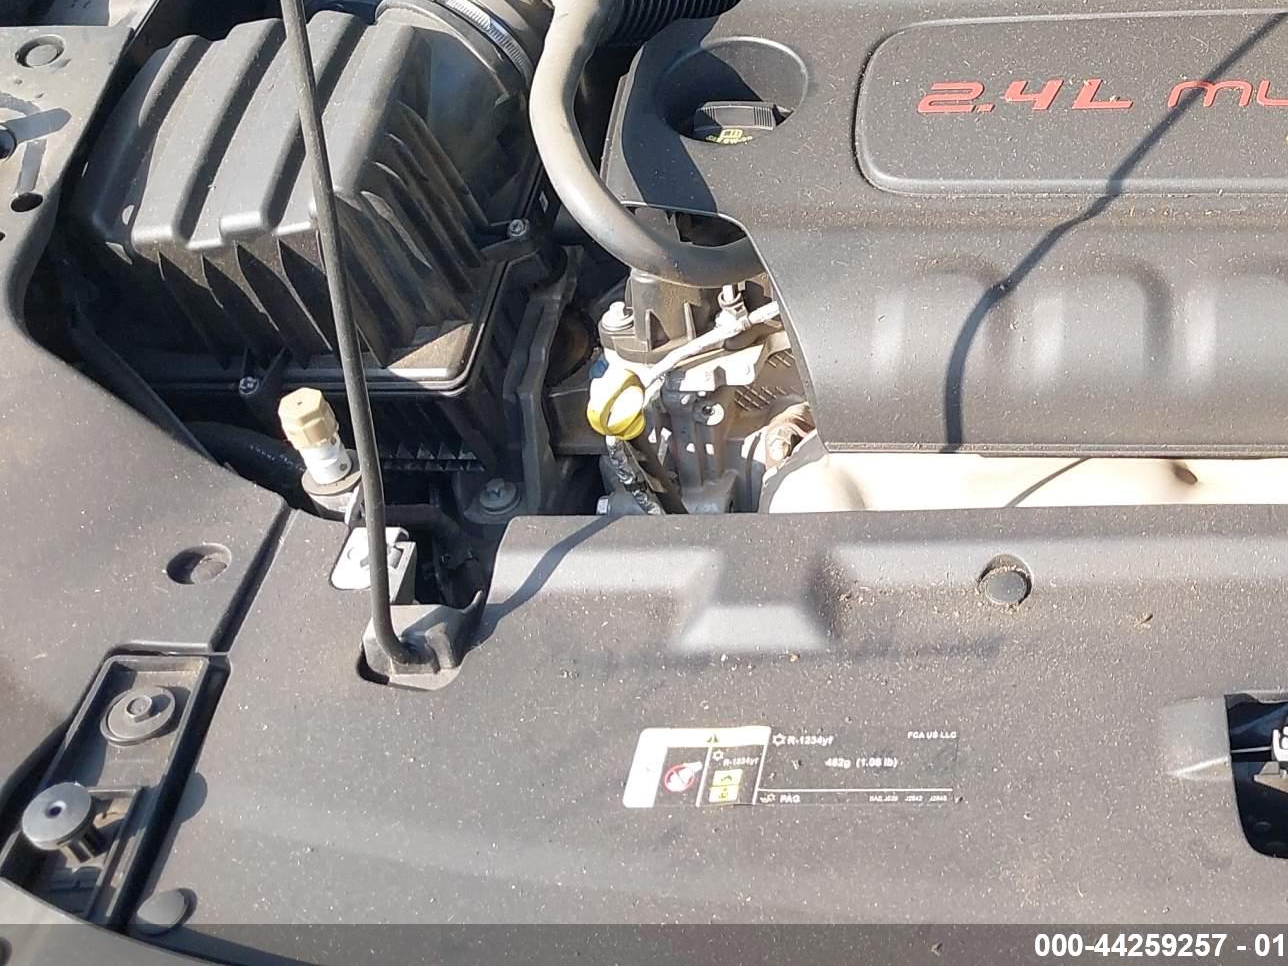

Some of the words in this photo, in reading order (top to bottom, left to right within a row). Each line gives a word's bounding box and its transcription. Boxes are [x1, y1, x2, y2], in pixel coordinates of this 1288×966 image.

[907, 731, 925, 739] FCA
[926, 730, 939, 740] US
[940, 731, 957, 739] LLC
[787, 736, 834, 746] R-1234yf
[780, 794, 801, 803] PAG
